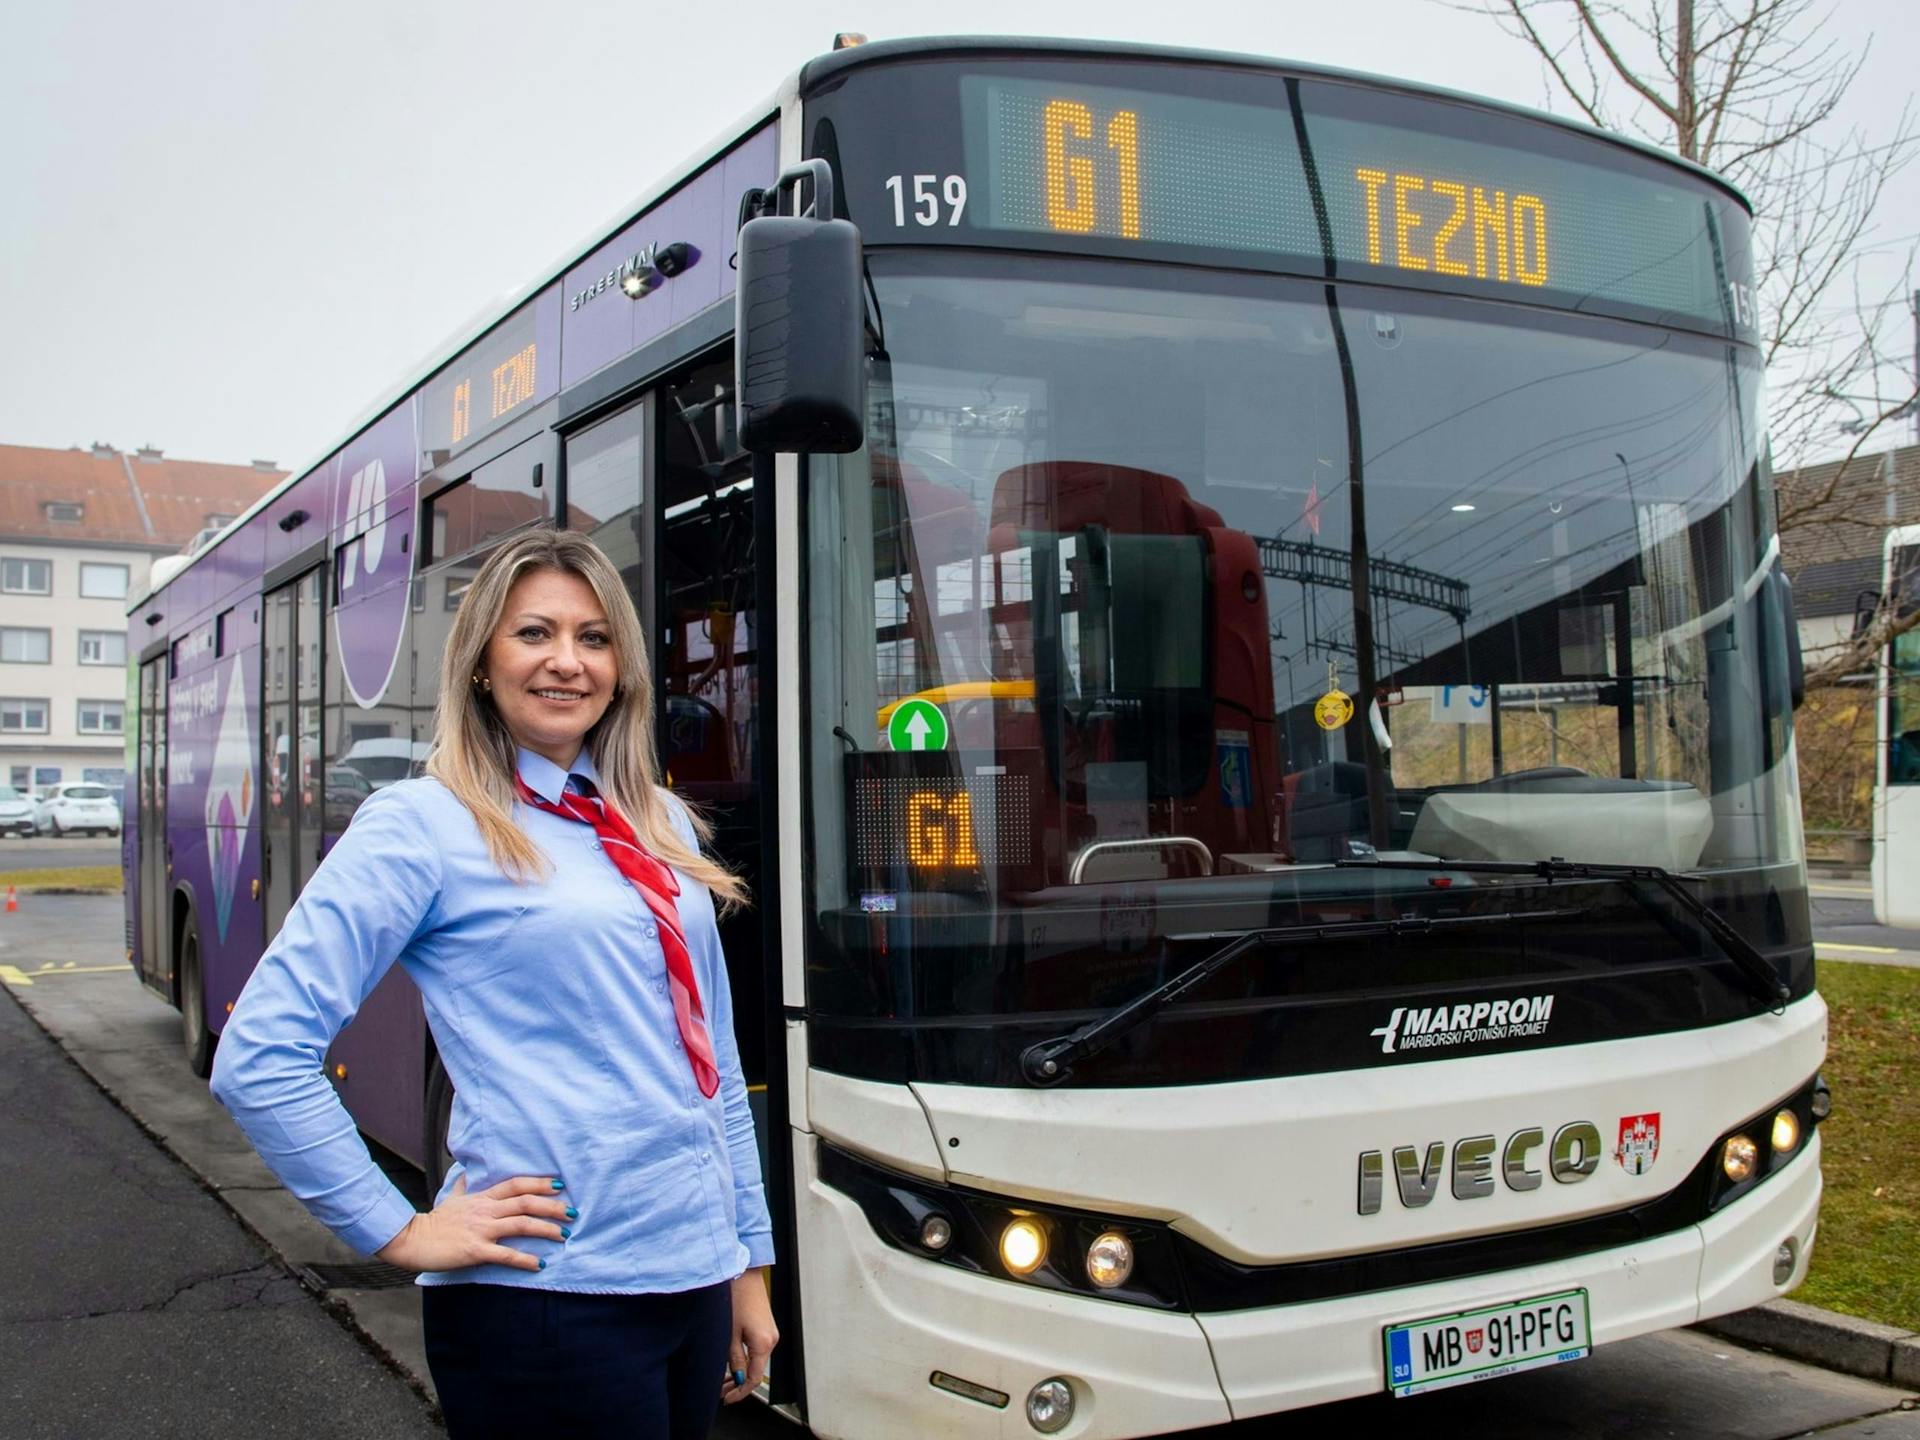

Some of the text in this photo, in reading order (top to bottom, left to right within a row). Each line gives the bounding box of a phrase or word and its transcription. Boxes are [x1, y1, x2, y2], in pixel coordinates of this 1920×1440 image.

[886, 174, 967, 227] 159
[1045, 99, 1548, 287] G1 TEZNO
[570, 240, 657, 312] STREETWAY
[452, 343, 536, 443] G1 TEZNO
[908, 791, 977, 867] G1
[1400, 1020, 1549, 1050] MARIBORSKI POTNIŠKI PROMET
[1403, 995, 1554, 1036] MARPROM
[1357, 1120, 1601, 1215] IVECO
[1394, 1363, 1410, 1378] SLO
[1423, 1303, 1574, 1372] MB 91-PFG
